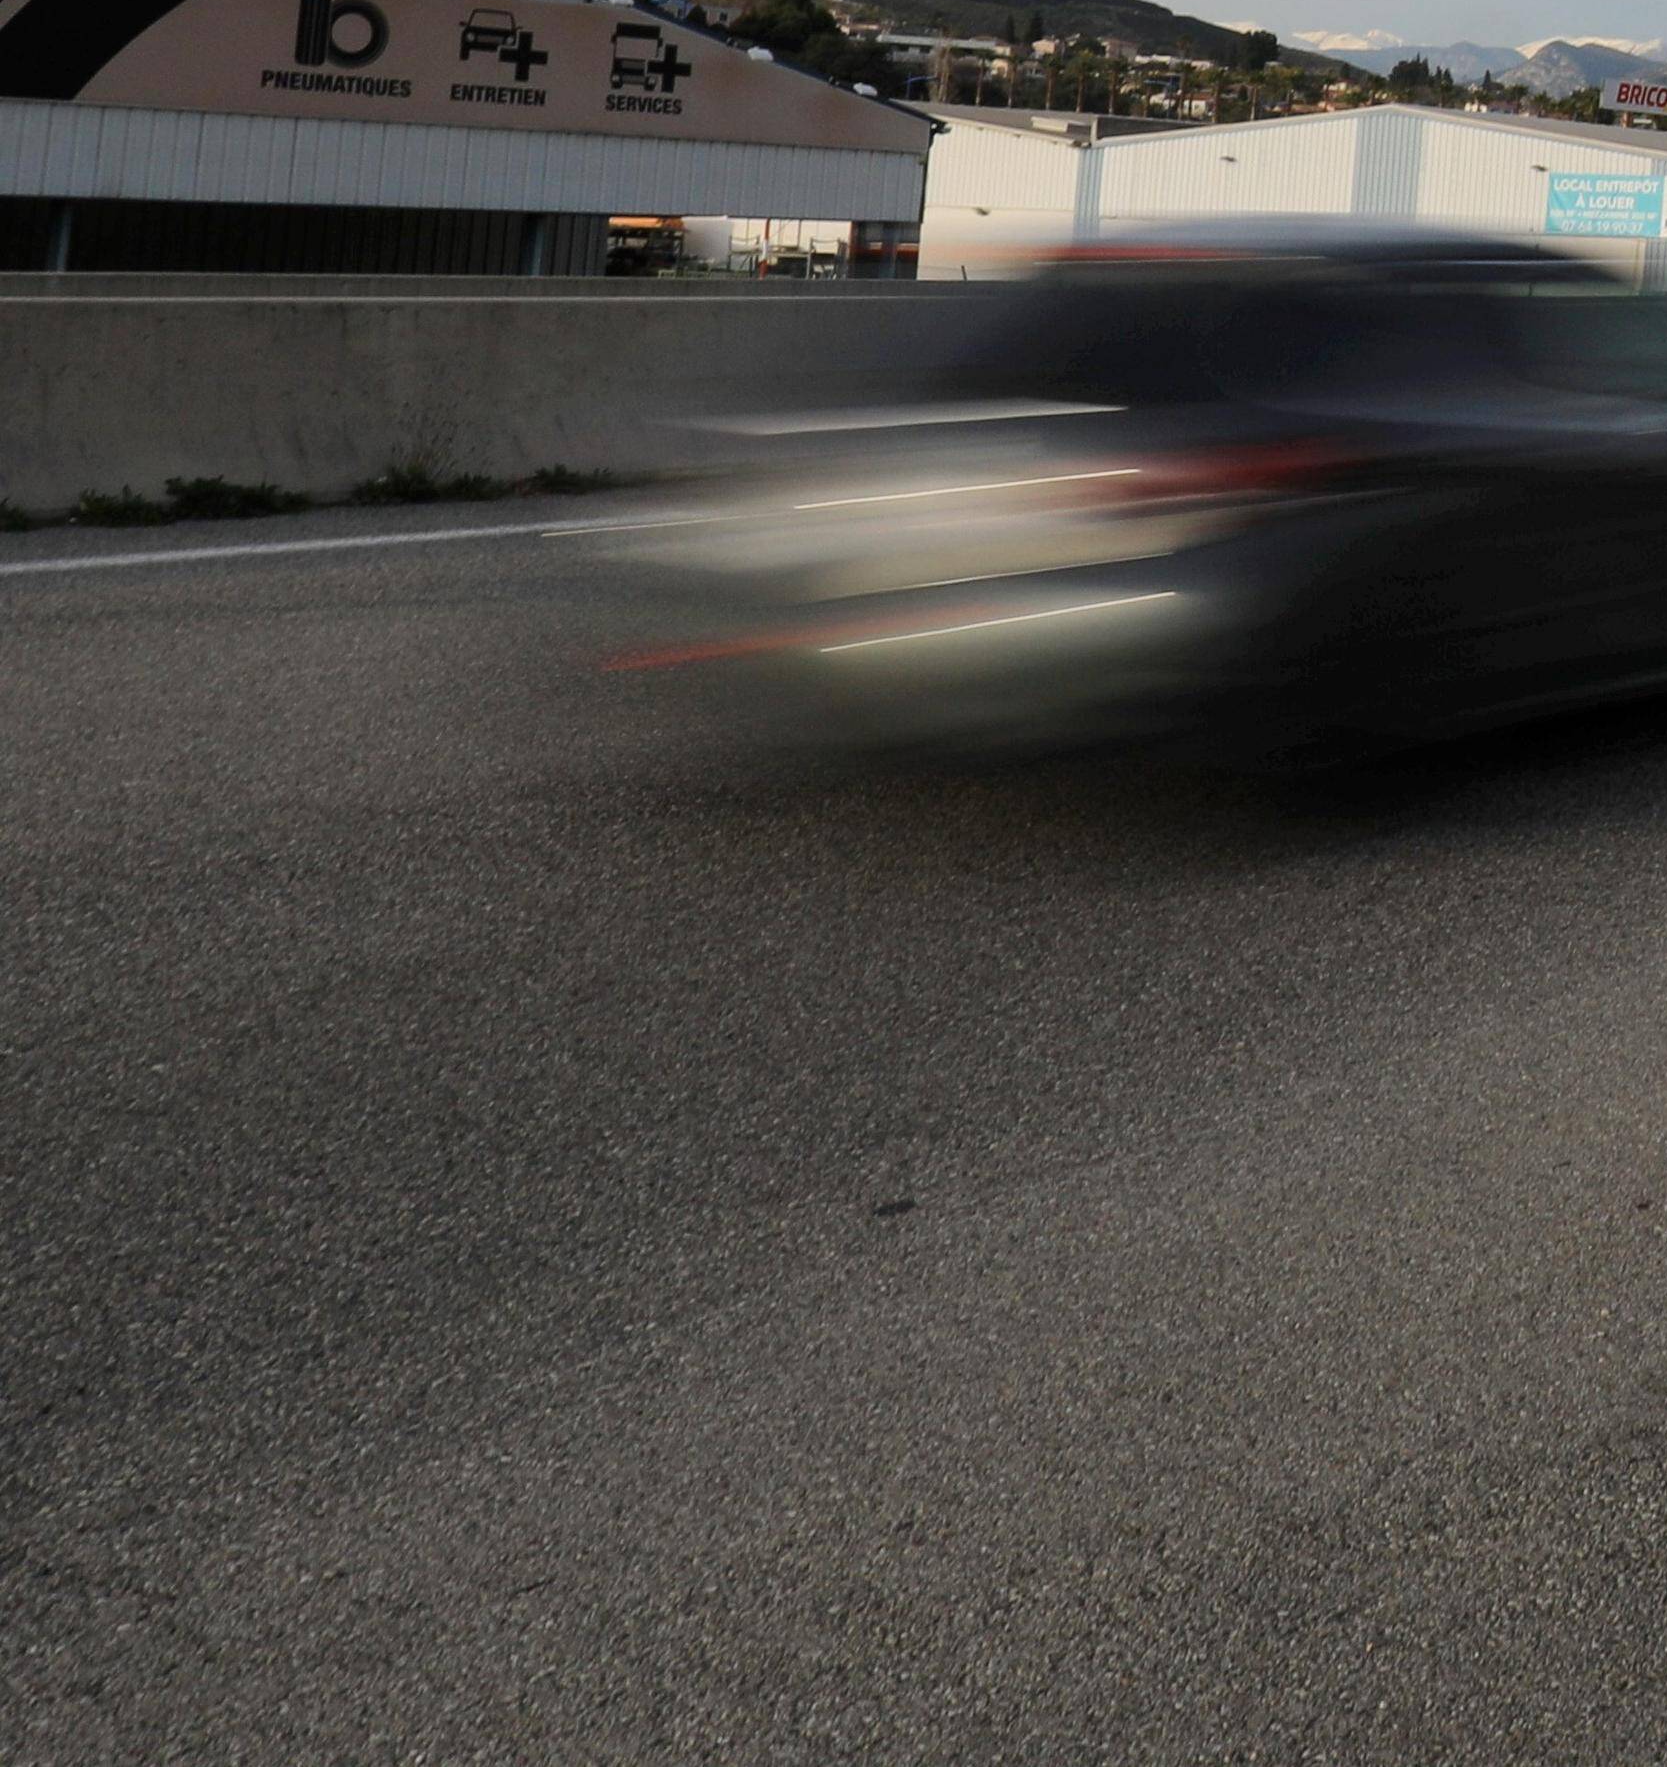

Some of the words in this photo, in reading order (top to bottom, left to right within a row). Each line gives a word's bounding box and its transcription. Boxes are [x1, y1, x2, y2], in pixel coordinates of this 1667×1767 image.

[261, 70, 412, 98] PNEUMATIQUES
[450, 83, 547, 107] ENTRETIEN
[605, 93, 683, 116] SERVICES
[1553, 178, 1593, 193] LOCAL
[1589, 196, 1635, 210] LOUER
